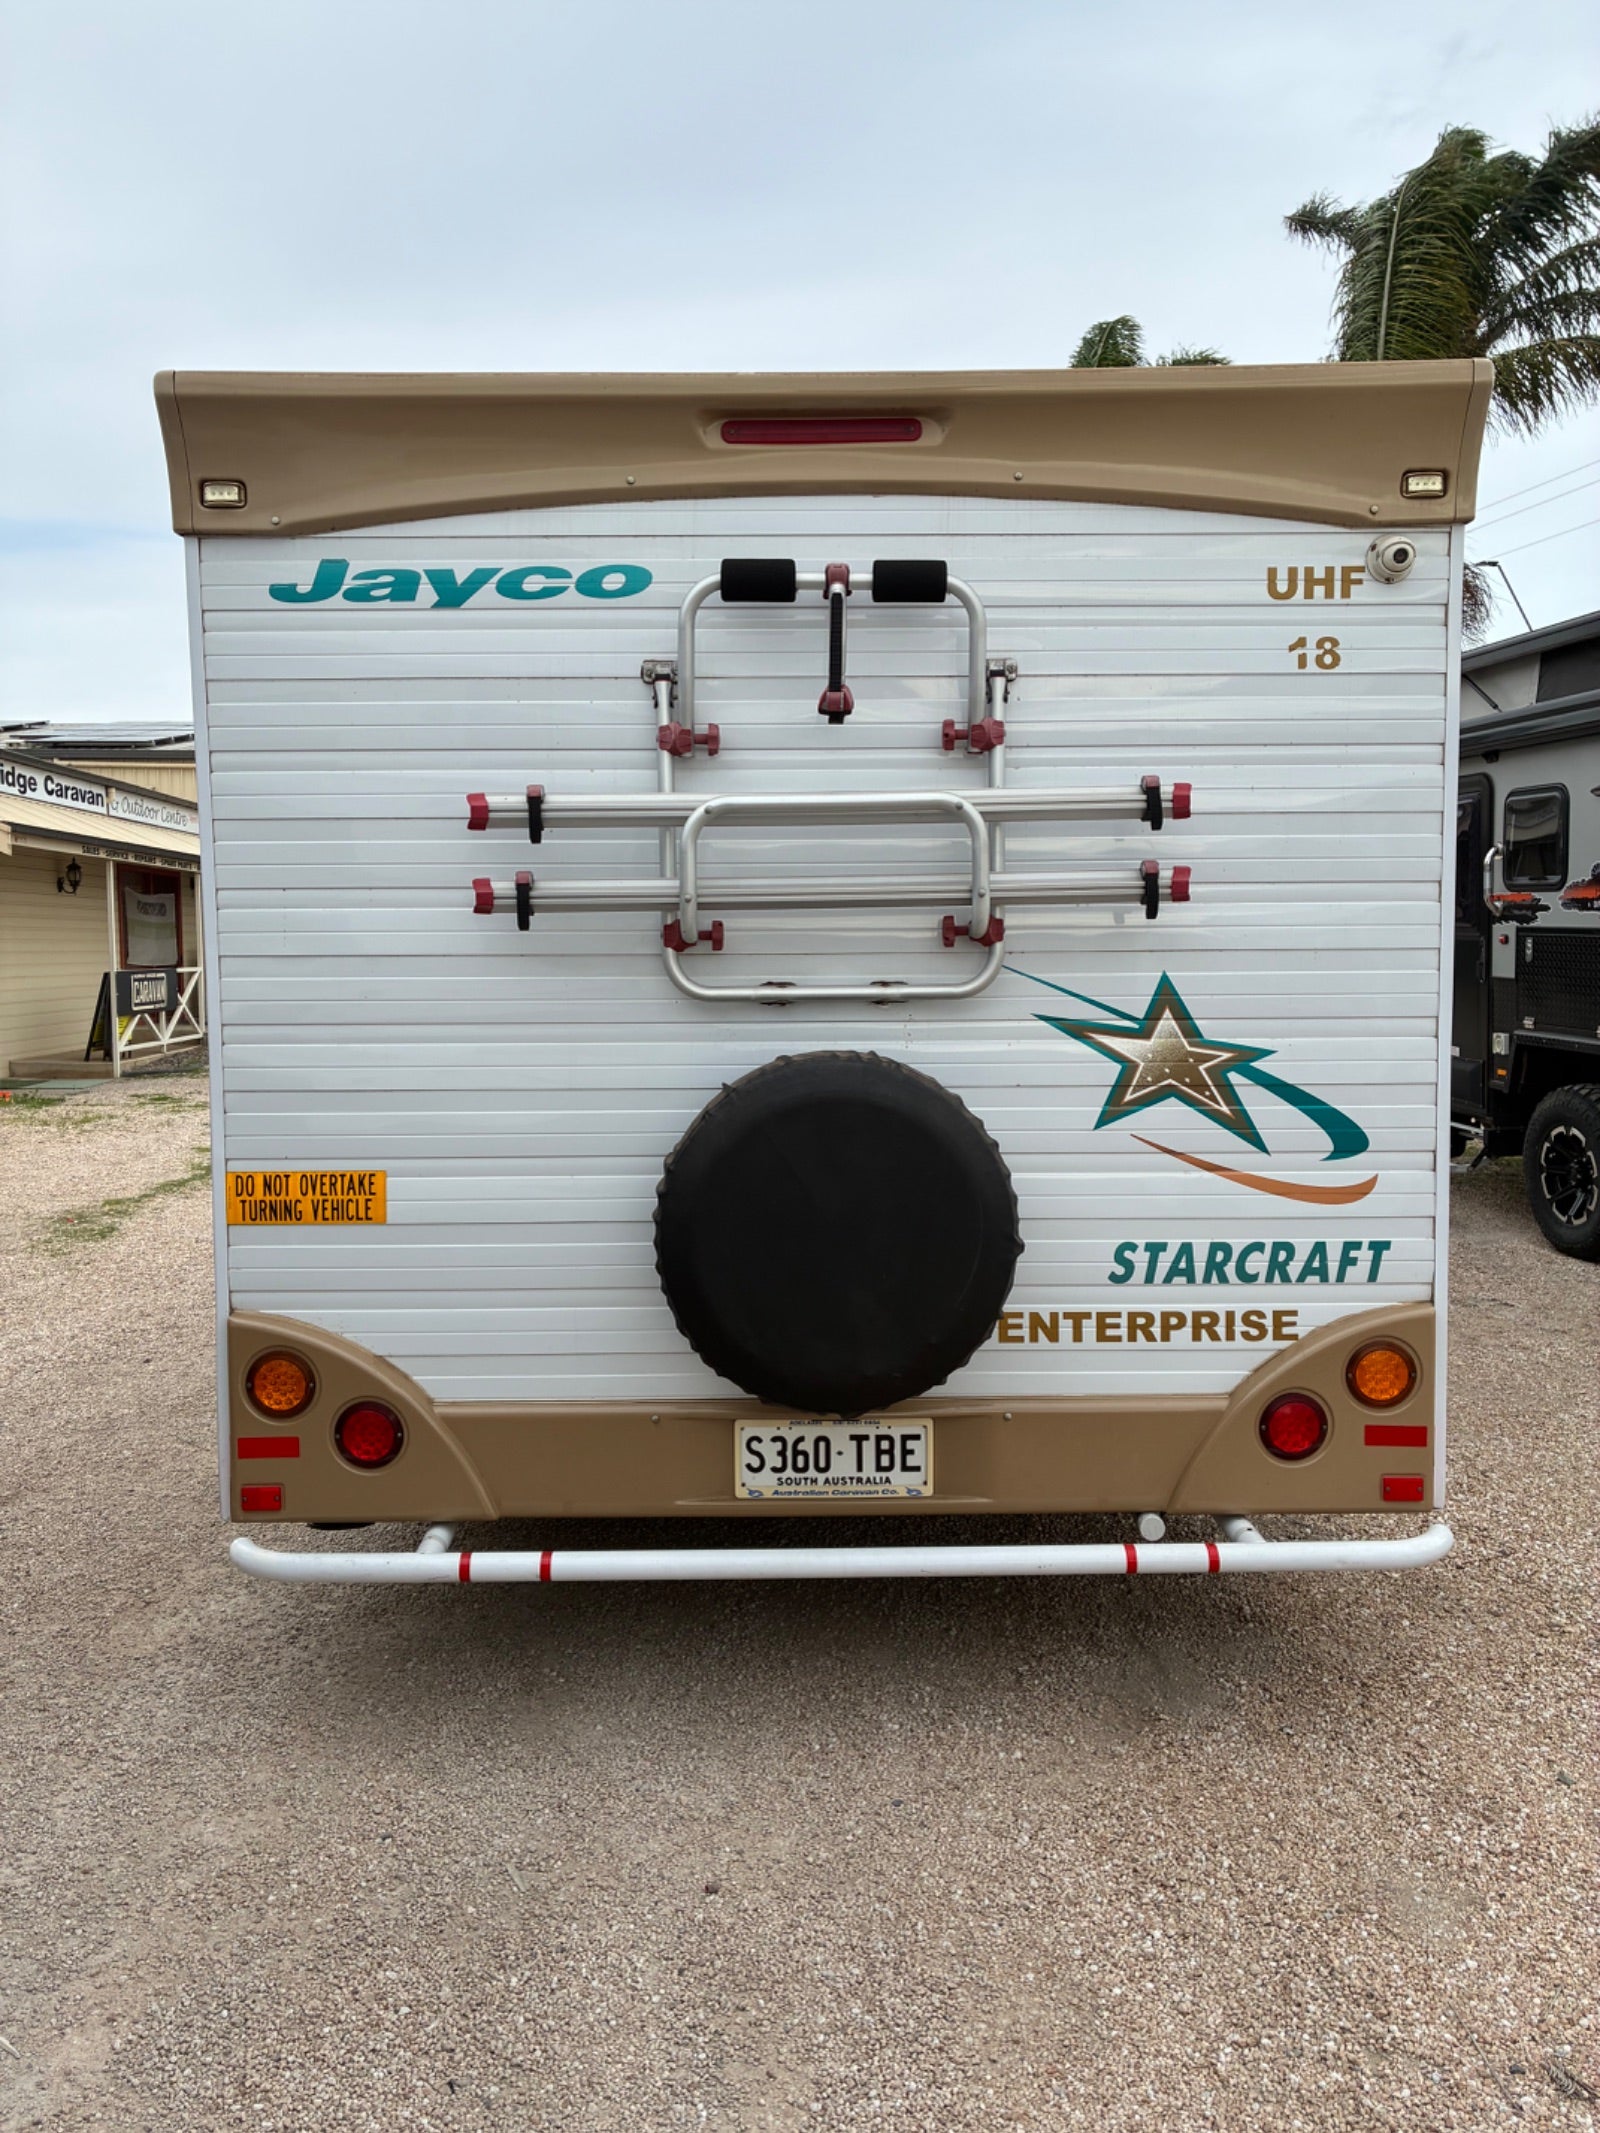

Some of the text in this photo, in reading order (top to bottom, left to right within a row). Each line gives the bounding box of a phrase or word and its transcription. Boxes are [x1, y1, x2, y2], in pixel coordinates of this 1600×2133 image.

[268, 558, 653, 609] Jayco
[1267, 565, 1366, 600] UHF
[1288, 636, 1341, 670] 18
[44, 774, 105, 808] Caravan
[121, 796, 160, 820] Outdoor
[161, 806, 188, 827] Centre
[235, 1173, 376, 1197] DO NOT OVERTAKE
[240, 1198, 373, 1221] TURNING VEHICLE
[1108, 1240, 1391, 1284] STARCRAFT
[998, 1310, 1299, 1343] ENTERPRISE
[772, 1489, 829, 1497] Australian
[777, 1476, 892, 1486] SOUTH AUSTRALIA
